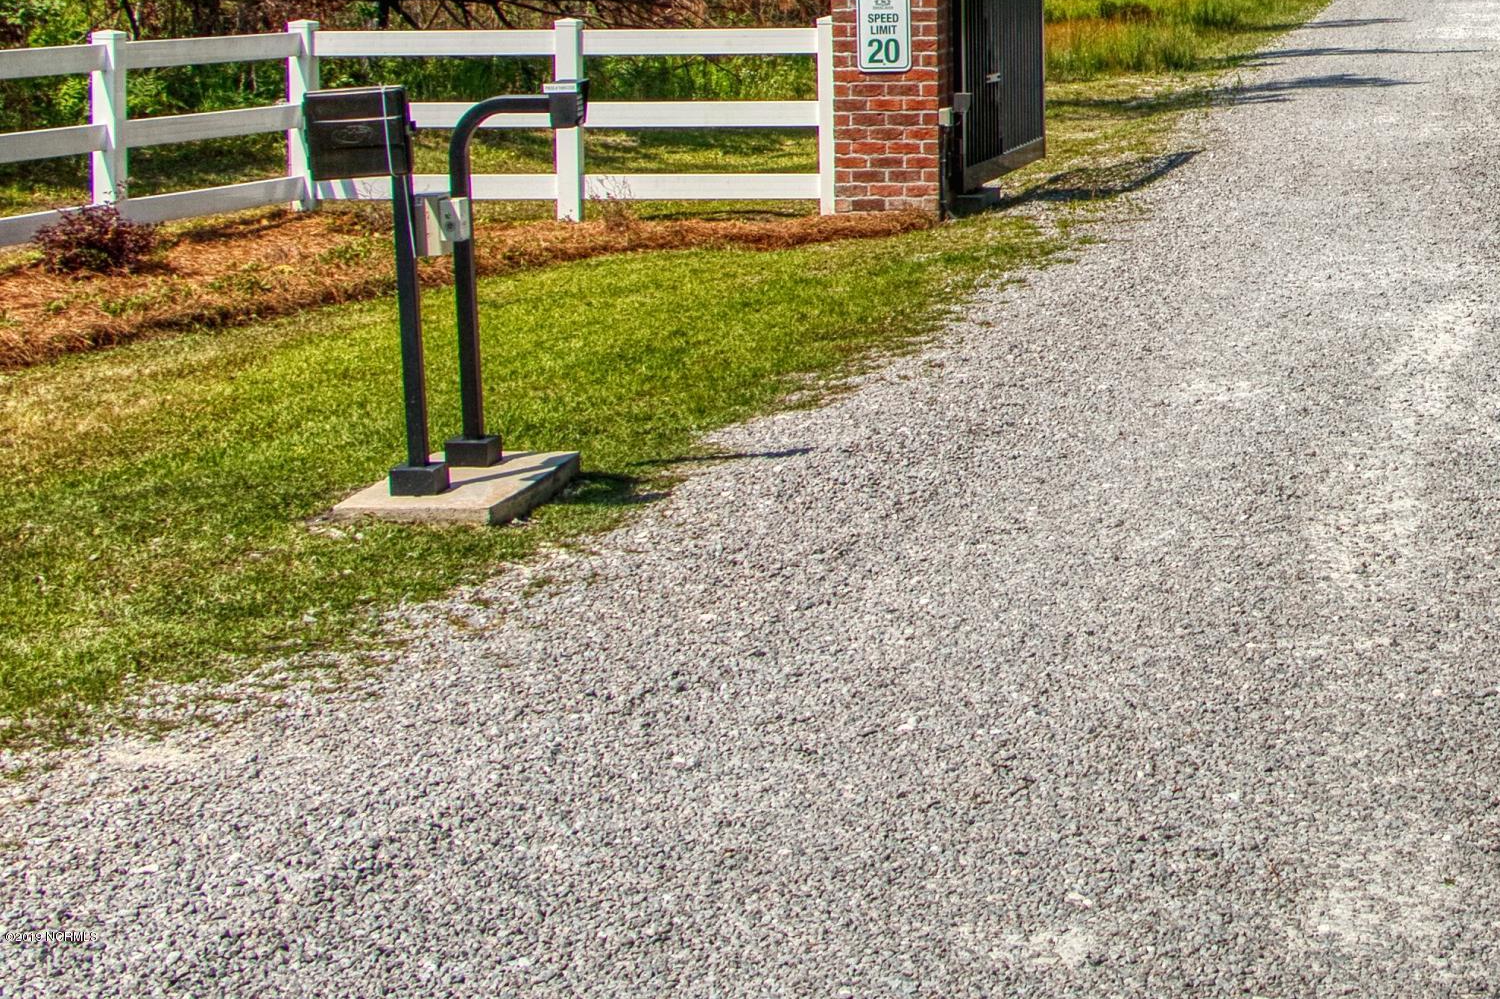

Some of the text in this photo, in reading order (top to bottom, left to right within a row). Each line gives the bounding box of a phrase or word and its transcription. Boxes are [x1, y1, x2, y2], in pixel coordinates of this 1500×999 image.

[868, 13, 899, 23] SPEED
[870, 25, 897, 35] LIMIT
[868, 38, 900, 63] 20
